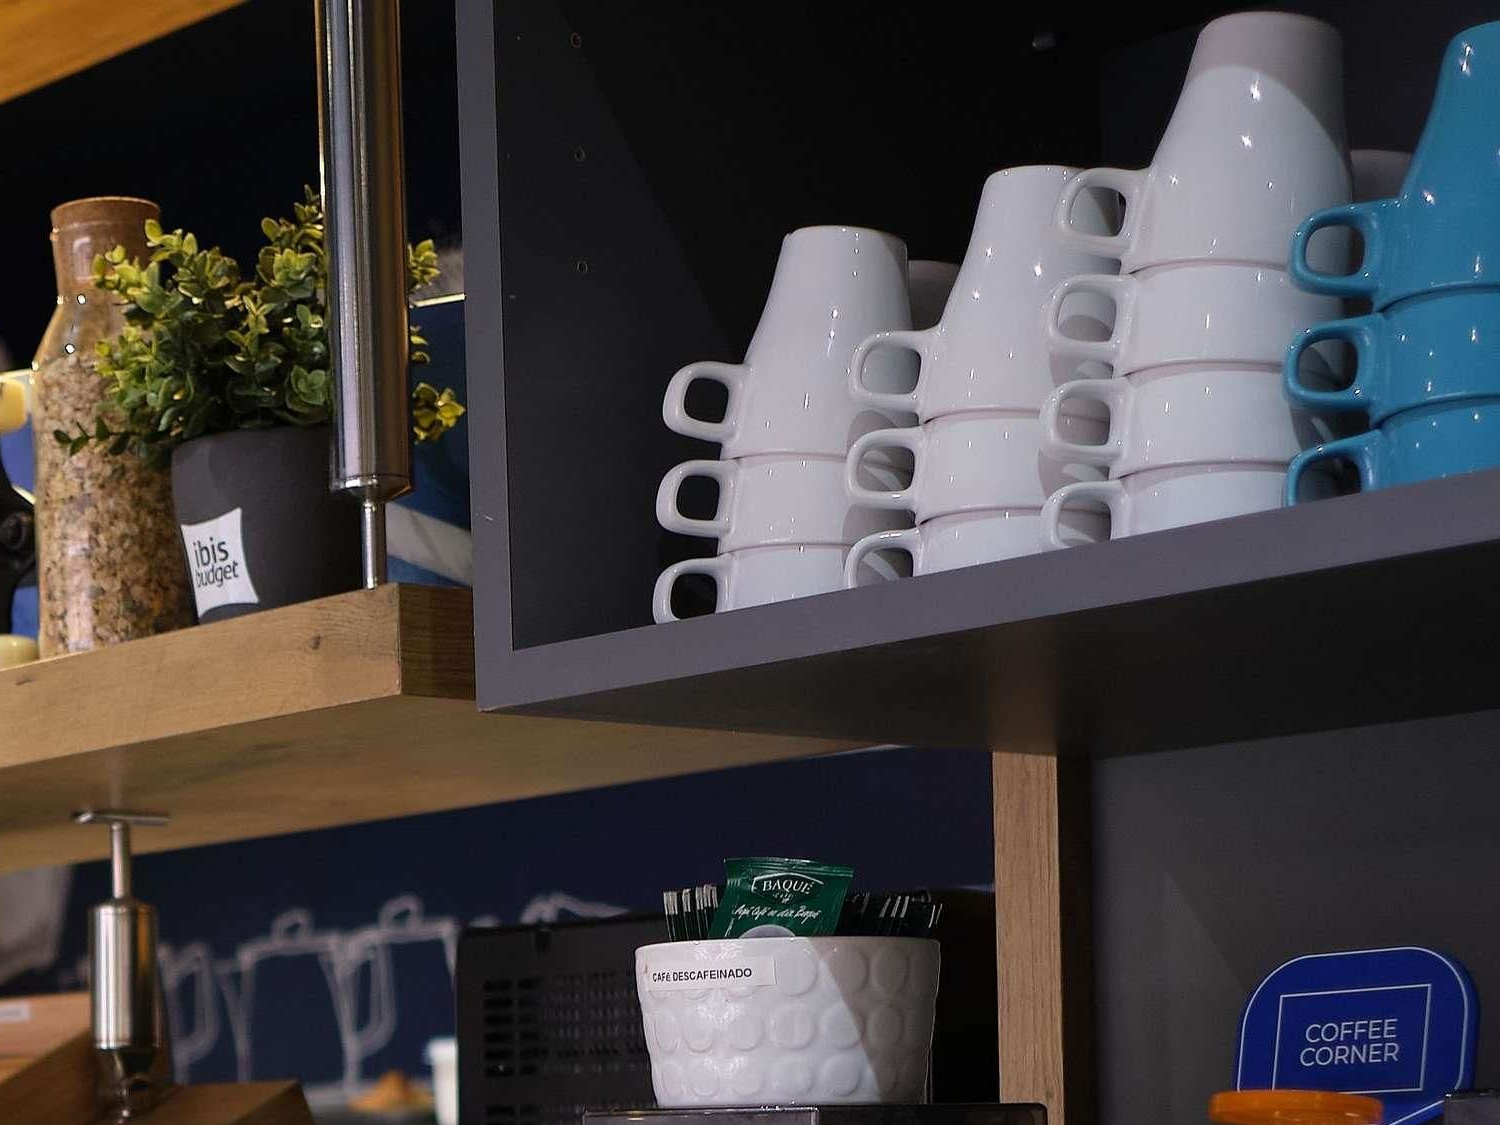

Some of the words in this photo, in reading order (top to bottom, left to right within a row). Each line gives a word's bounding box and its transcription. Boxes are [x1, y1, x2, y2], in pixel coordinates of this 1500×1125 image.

[193, 536, 229, 568] ibis
[195, 560, 239, 588] budget
[673, 968, 752, 982] DESCAFEINADO
[1305, 1018, 1398, 1043] COFFEE
[1300, 1042, 1399, 1067] CORNER
